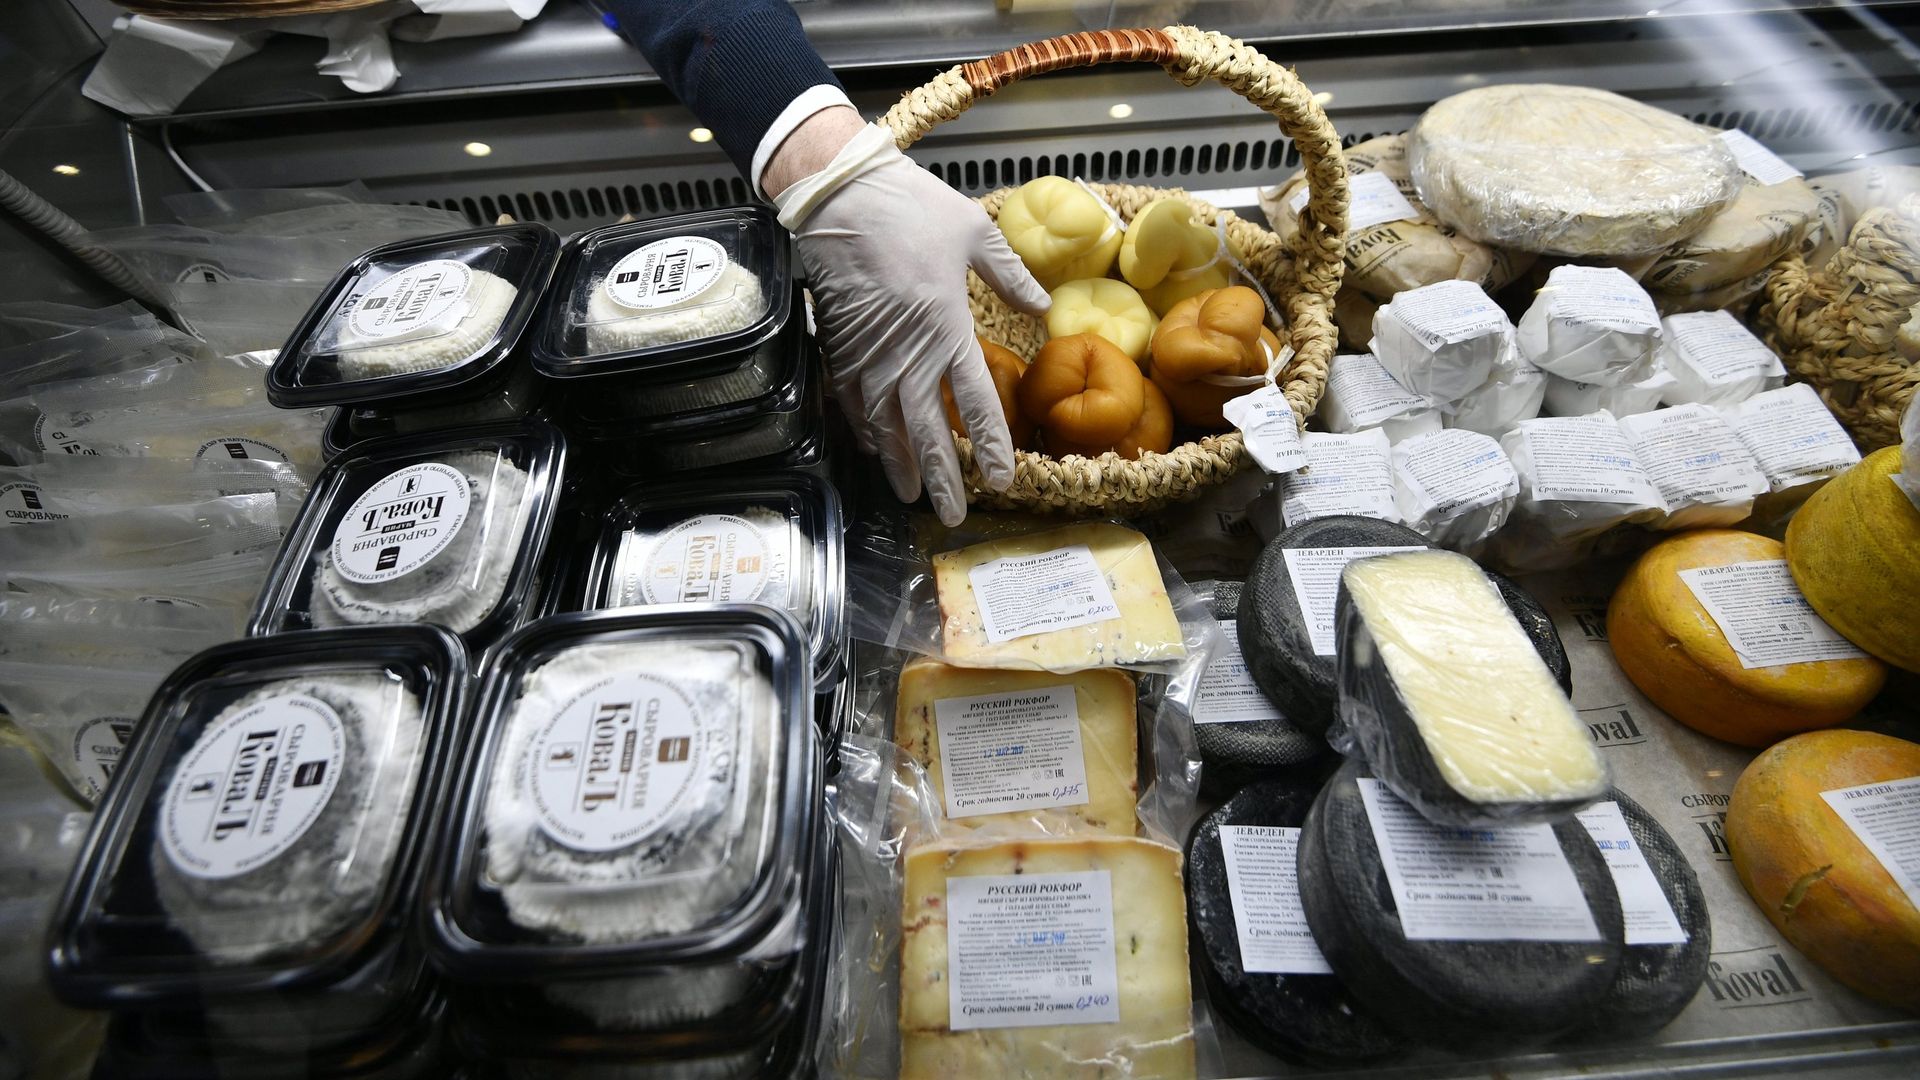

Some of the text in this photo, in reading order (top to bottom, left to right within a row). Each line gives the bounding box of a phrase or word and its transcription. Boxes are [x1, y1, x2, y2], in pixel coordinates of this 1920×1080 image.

[637, 253, 657, 298] СЫРОВАРНЯ
[374, 277, 412, 326] СЫРОВАРНЯ
[226, 438, 280, 454] НАТУРАЛЬНОГО
[1539, 486, 1559, 494] Срок
[1438, 503, 1456, 513] Срок
[1457, 491, 1488, 507] годности
[384, 522, 413, 531] МАРИИ
[352, 527, 437, 552] СЫРОВАРНЯ
[419, 514, 462, 562] РЕМЕСЛЕННЫЙ
[333, 538, 342, 564] МОЛОКА
[1000, 551, 1070, 568] РУССКИЙ РОКФОР
[1296, 549, 1344, 557] ЛЕВАРДЕН
[339, 562, 385, 580] НАТУРАЛЬНОГО
[720, 533, 736, 602] СЫРОВАРНЯ
[1697, 564, 1742, 577] ЛЕВАРДЕН
[1063, 613, 1085, 623] суток
[970, 695, 1051, 711] РУССКИЙ РОКФОР
[632, 697, 660, 810] СЫРОВАРНЯ
[261, 724, 306, 836] СЫРОВАРНЯ
[956, 791, 1050, 808] Срок годности 20 суток
[1842, 784, 1892, 801] ЛЕВАРДЕН
[1233, 827, 1285, 837] ЛЕВАРДЕН
[987, 882, 1082, 895] РУССКИЙ РОКФОР
[1405, 889, 1432, 902] Срок
[1249, 927, 1313, 938] Срок годност
[962, 1002, 1075, 1016] Срок годности 20 суток
